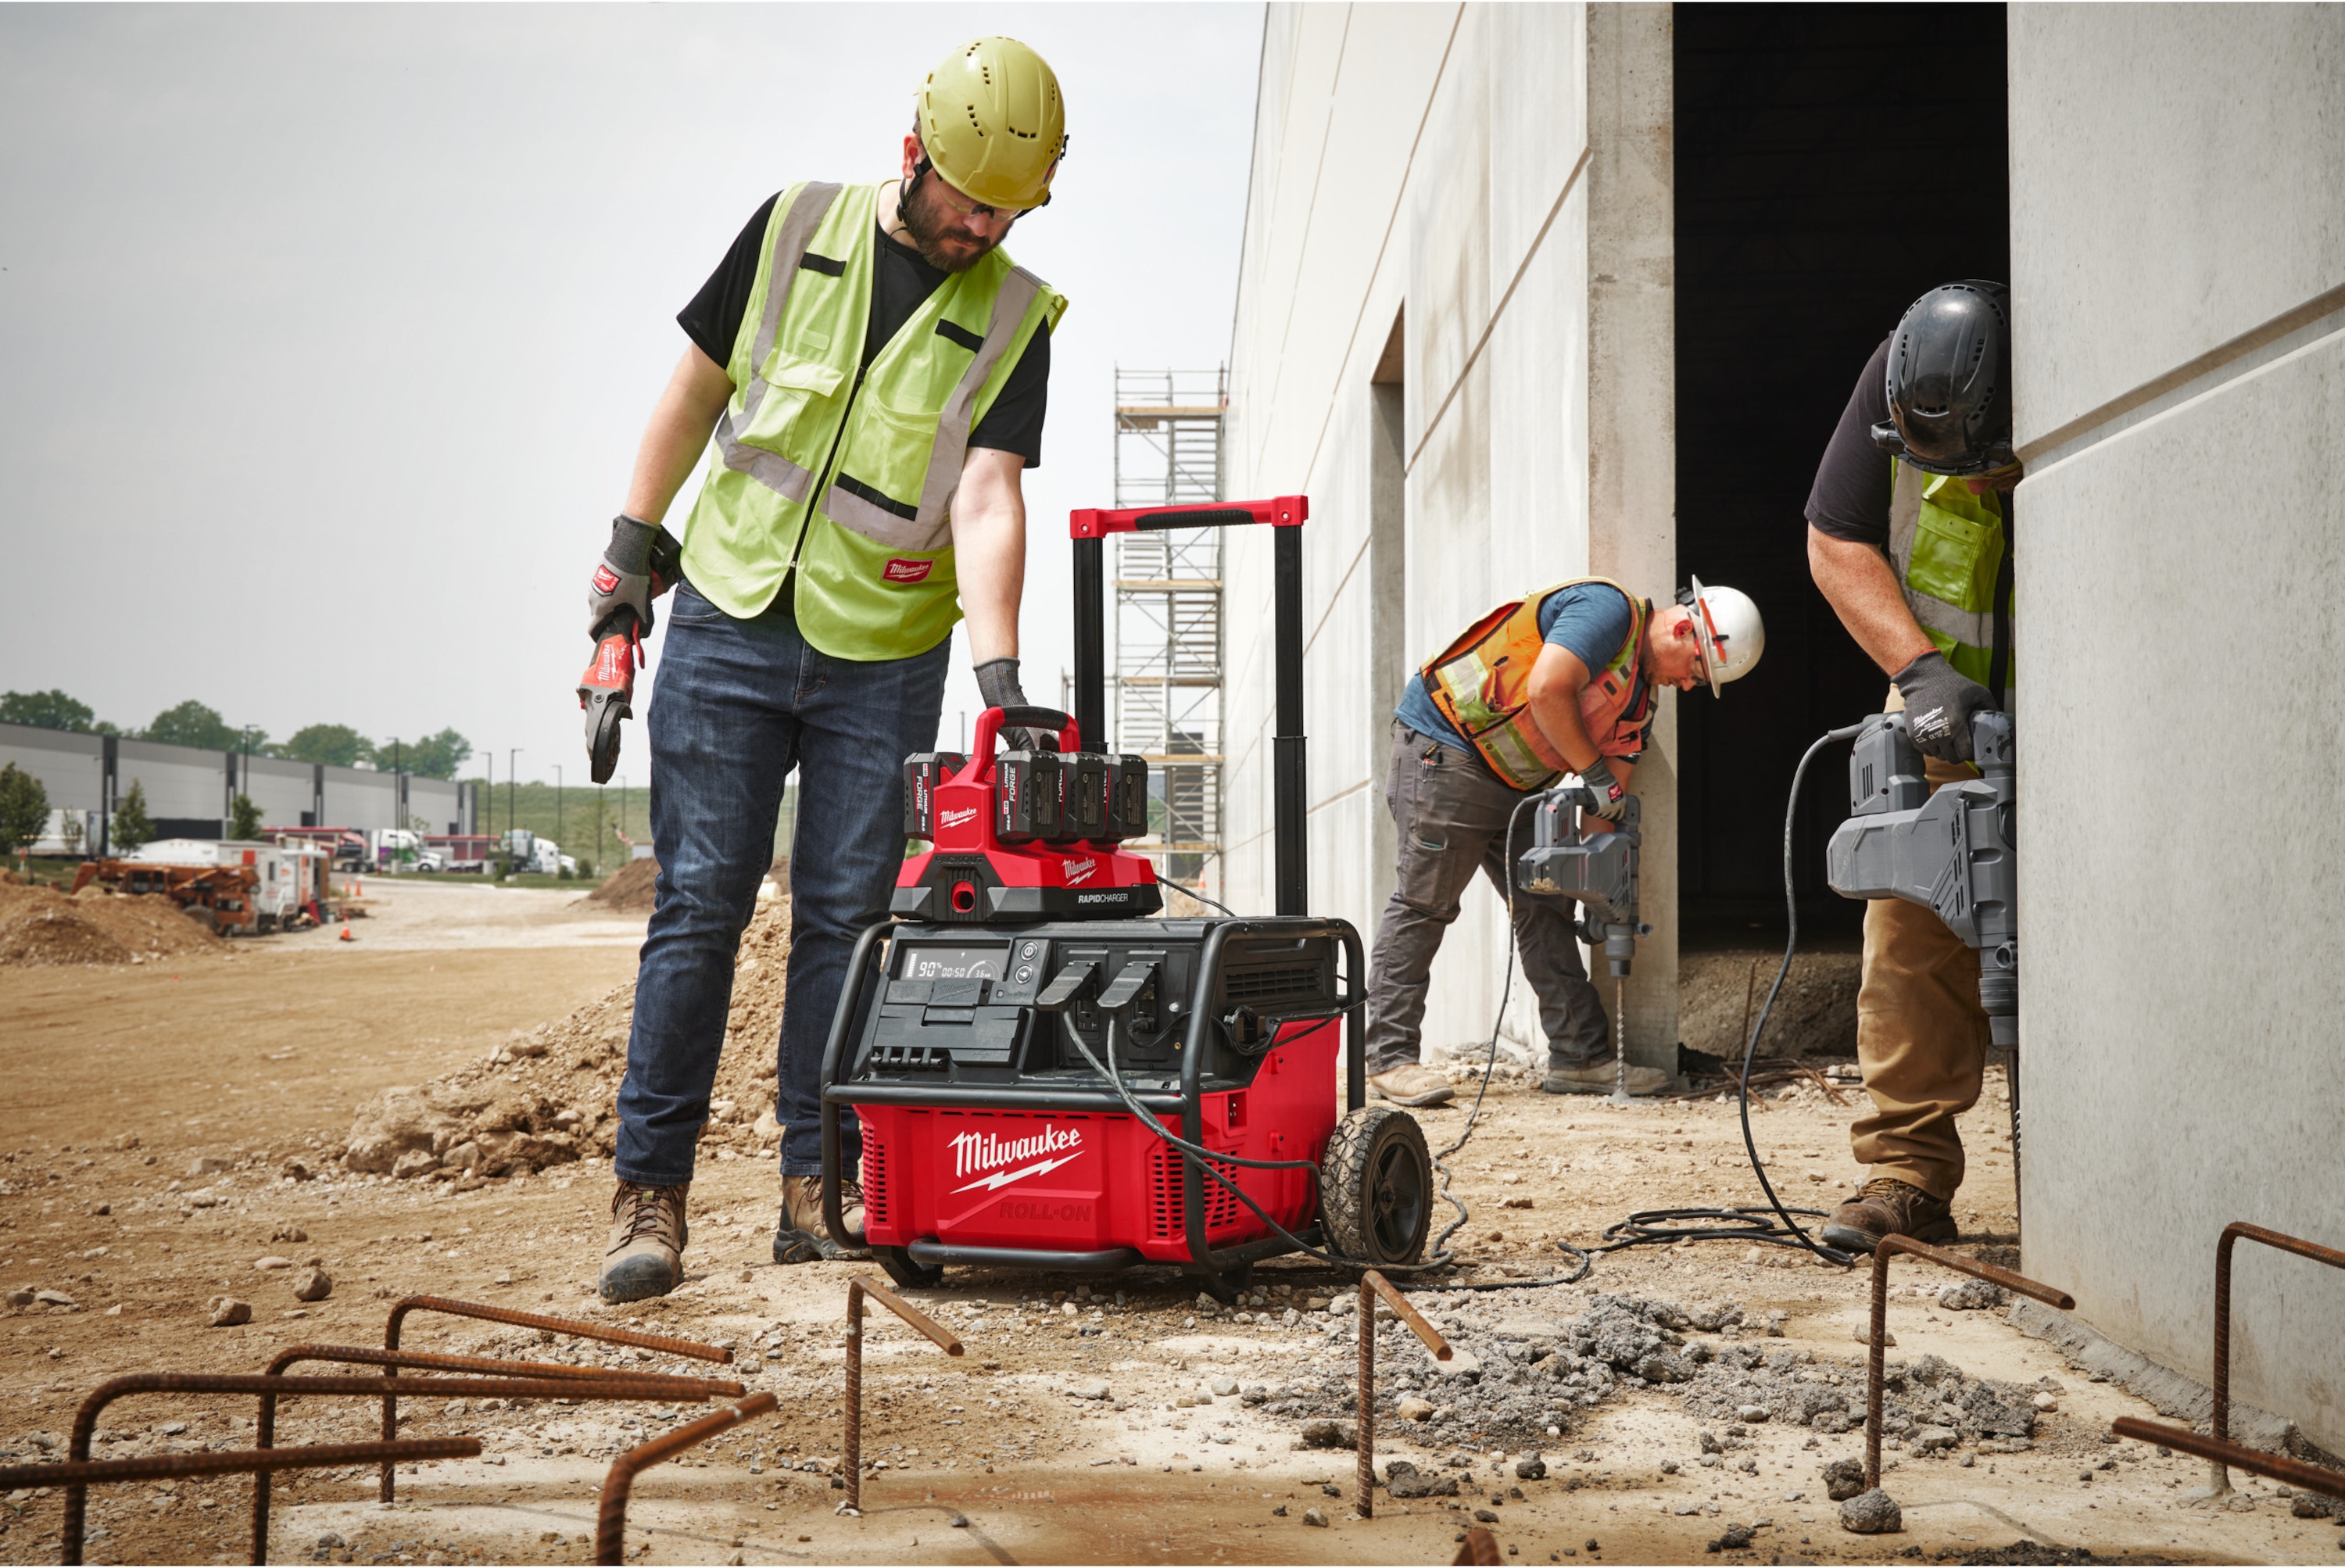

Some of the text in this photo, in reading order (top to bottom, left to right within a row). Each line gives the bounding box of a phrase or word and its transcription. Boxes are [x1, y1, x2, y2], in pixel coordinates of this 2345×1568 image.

[890, 563, 929, 575] Milwaukee
[597, 643, 610, 682] Milwaukee
[939, 807, 977, 824] Milwaukee
[1062, 856, 1097, 879] Milwaukee
[941, 967, 966, 978] 00:50
[946, 1122, 1083, 1179] Milwaukee
[998, 1201, 1093, 1223] ROLL-ON
